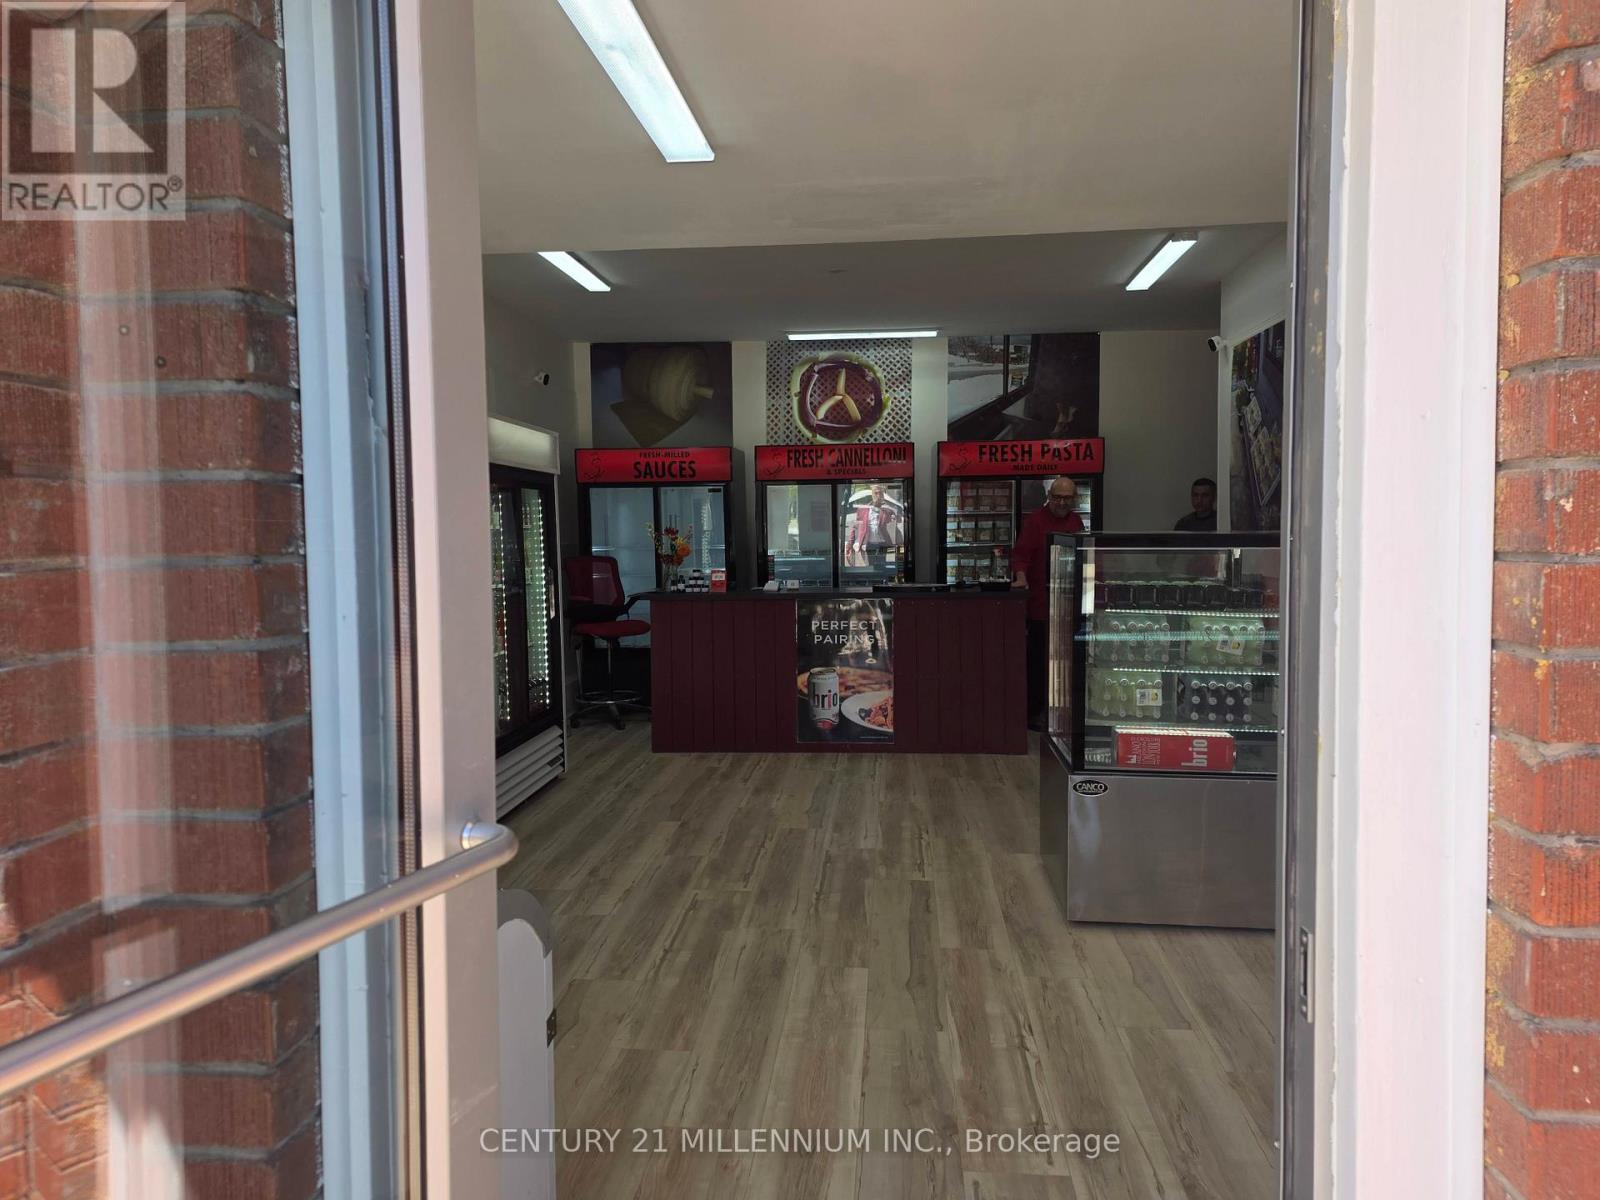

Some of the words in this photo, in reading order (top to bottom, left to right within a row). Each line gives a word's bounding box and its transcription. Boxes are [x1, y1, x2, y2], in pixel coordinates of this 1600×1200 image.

[787, 448, 825, 469] FRESH
[978, 443, 1033, 463] FRESH
[1041, 442, 1094, 461] PASTA
[633, 460, 697, 479] SAUCES
[811, 620, 877, 632] PERFECT
[814, 634, 875, 645] PAIRING
[1181, 738, 1208, 768] brio
[1076, 783, 1105, 791] CANCO
